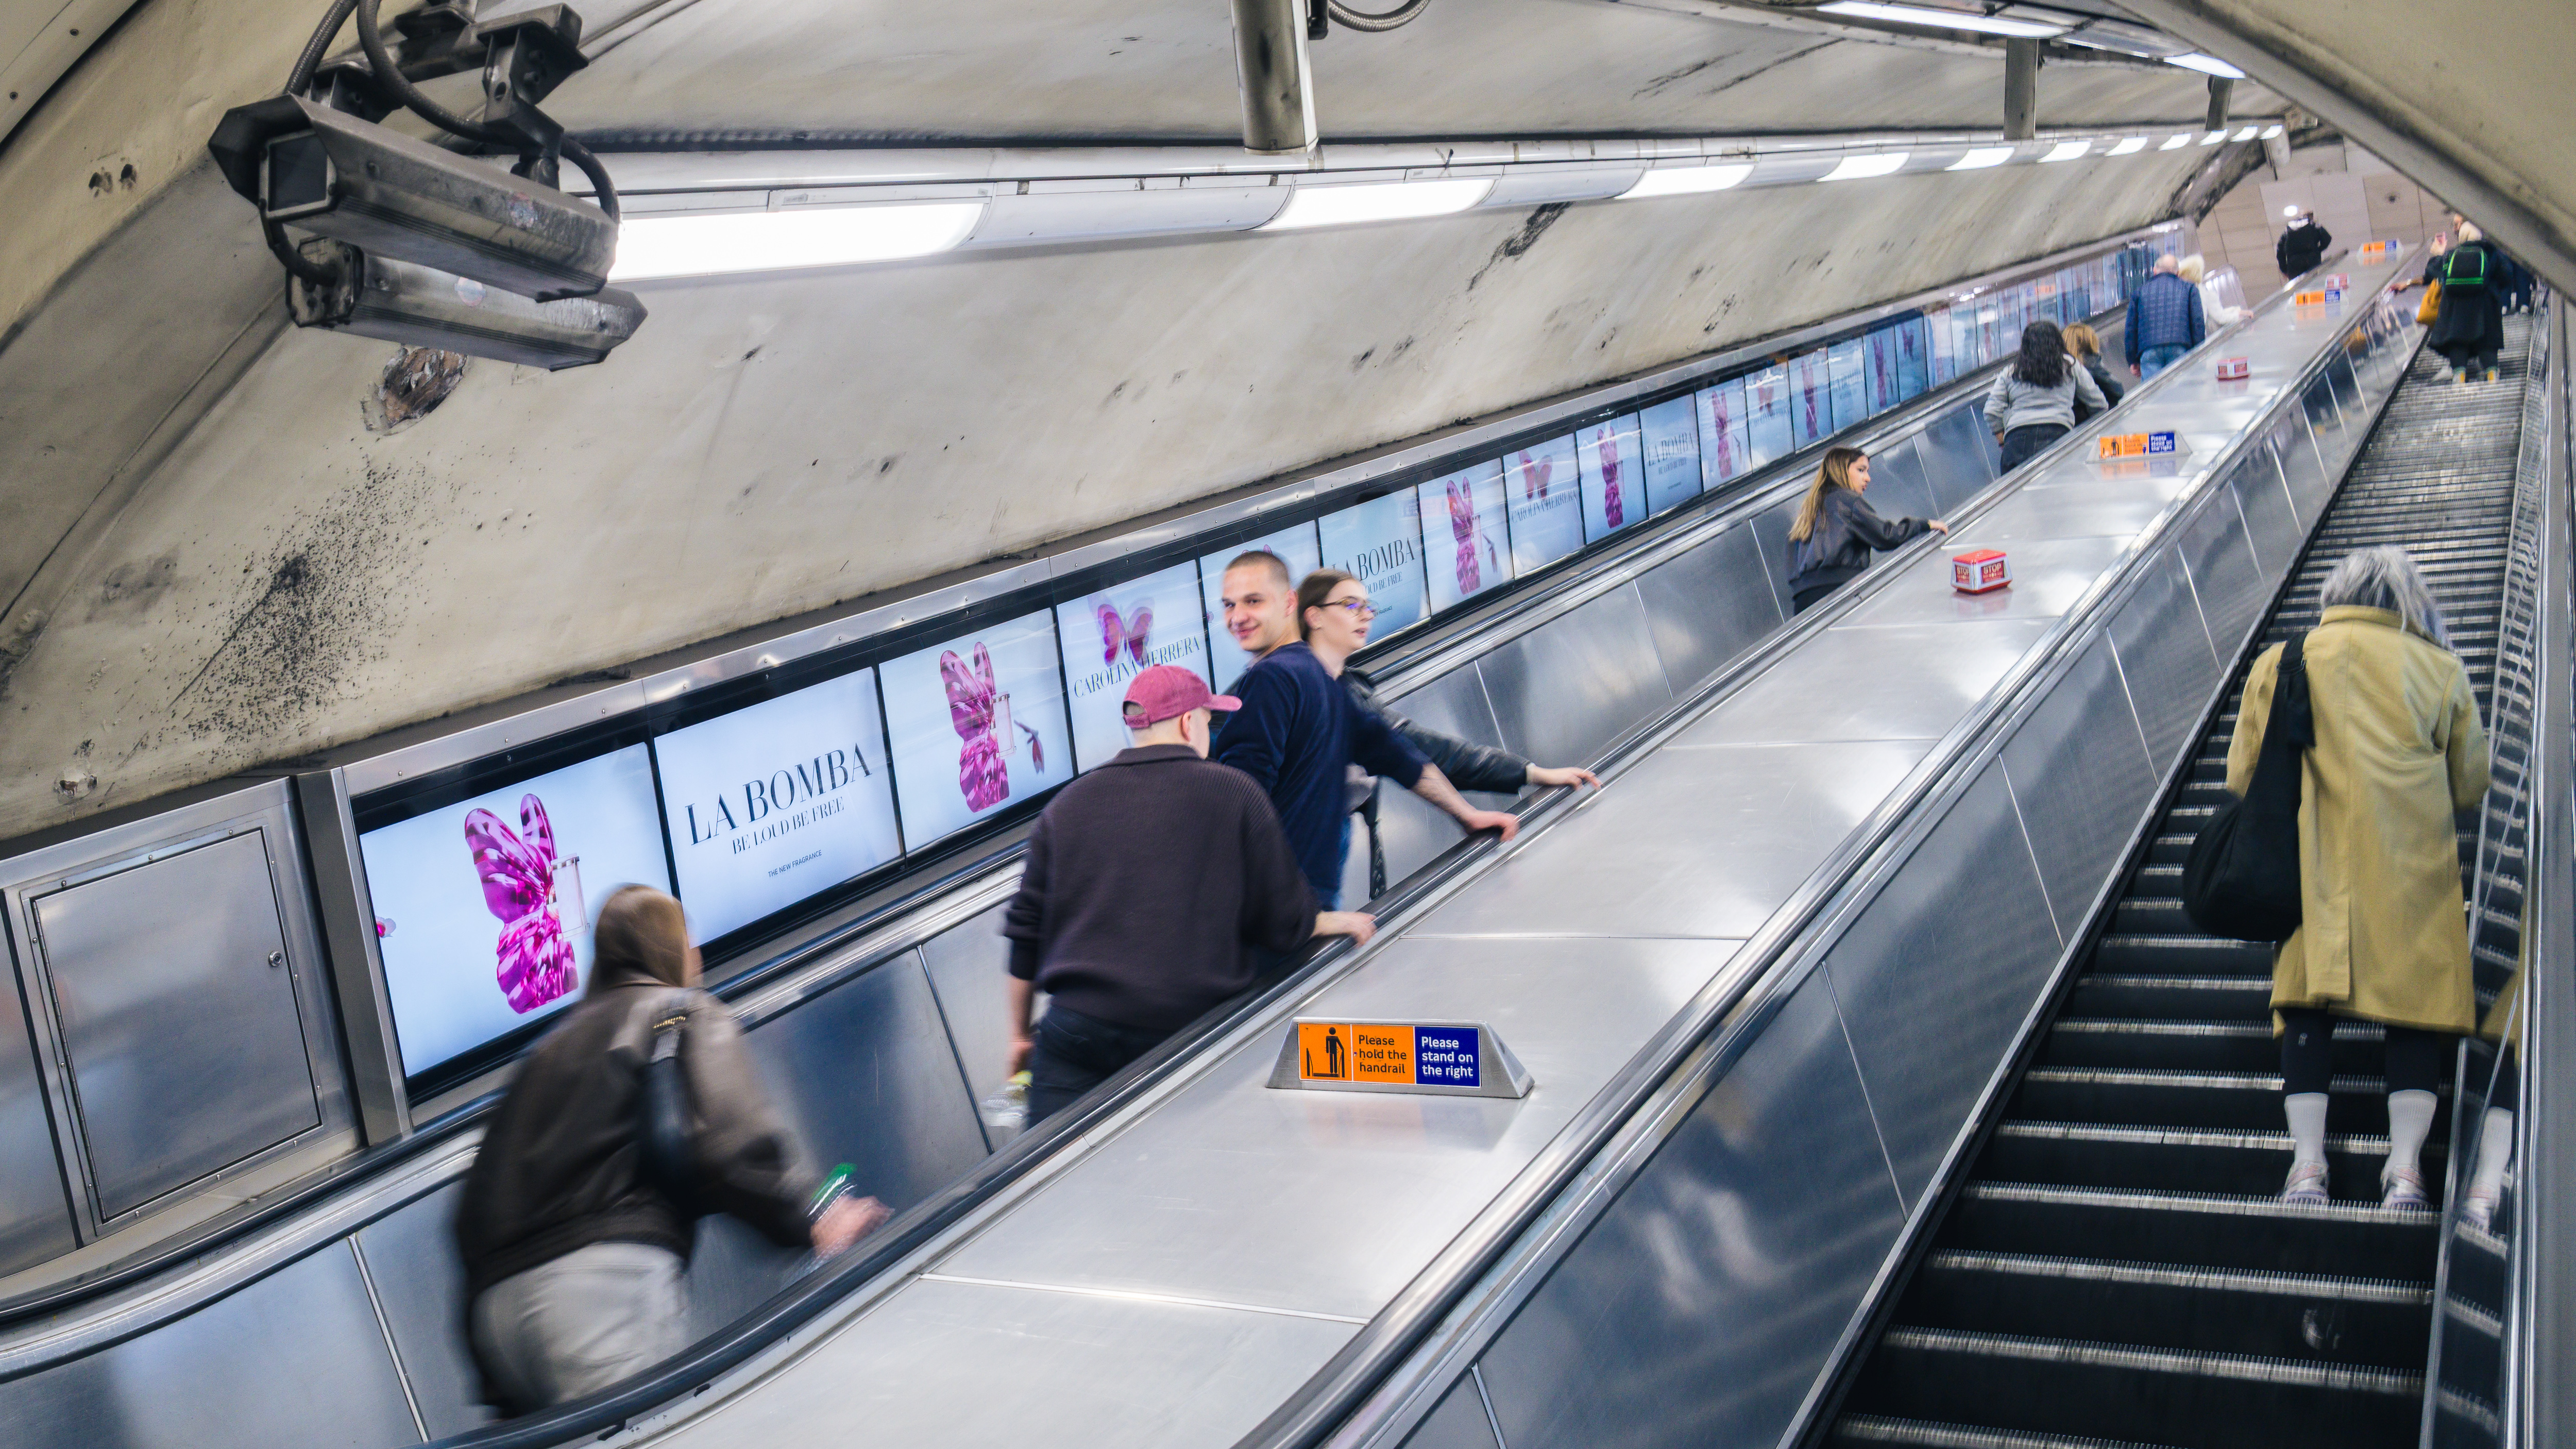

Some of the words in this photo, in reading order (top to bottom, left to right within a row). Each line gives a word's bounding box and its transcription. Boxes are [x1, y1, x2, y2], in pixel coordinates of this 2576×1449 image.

[1357, 536, 1415, 581] BOMBA
[1365, 582, 1378, 595] OUD
[1379, 578, 1387, 590] BE
[1387, 571, 1403, 586] FREE
[1074, 659, 1139, 698] CAROLINA
[1142, 635, 1200, 668] HERRERA
[685, 793, 739, 846] LA
[742, 743, 872, 823] BOMBA
[732, 834, 750, 854] BE
[754, 819, 789, 846] LOUD
[792, 811, 809, 830] BE
[812, 796, 844, 822] FREE
[768, 868, 778, 878] THE
[779, 863, 791, 873] NEW
[792, 850, 822, 868] FRAGRANCE
[1358, 1034, 1395, 1046] Please
[1421, 1036, 1459, 1048] Please
[1359, 1049, 1384, 1059] hold
[1387, 1050, 1406, 1060] the
[1422, 1052, 1454, 1063] stand
[1458, 1053, 1473, 1063] on
[1360, 1062, 1405, 1074] handrail
[1422, 1065, 1442, 1075] the
[1446, 1065, 1473, 1079] right
